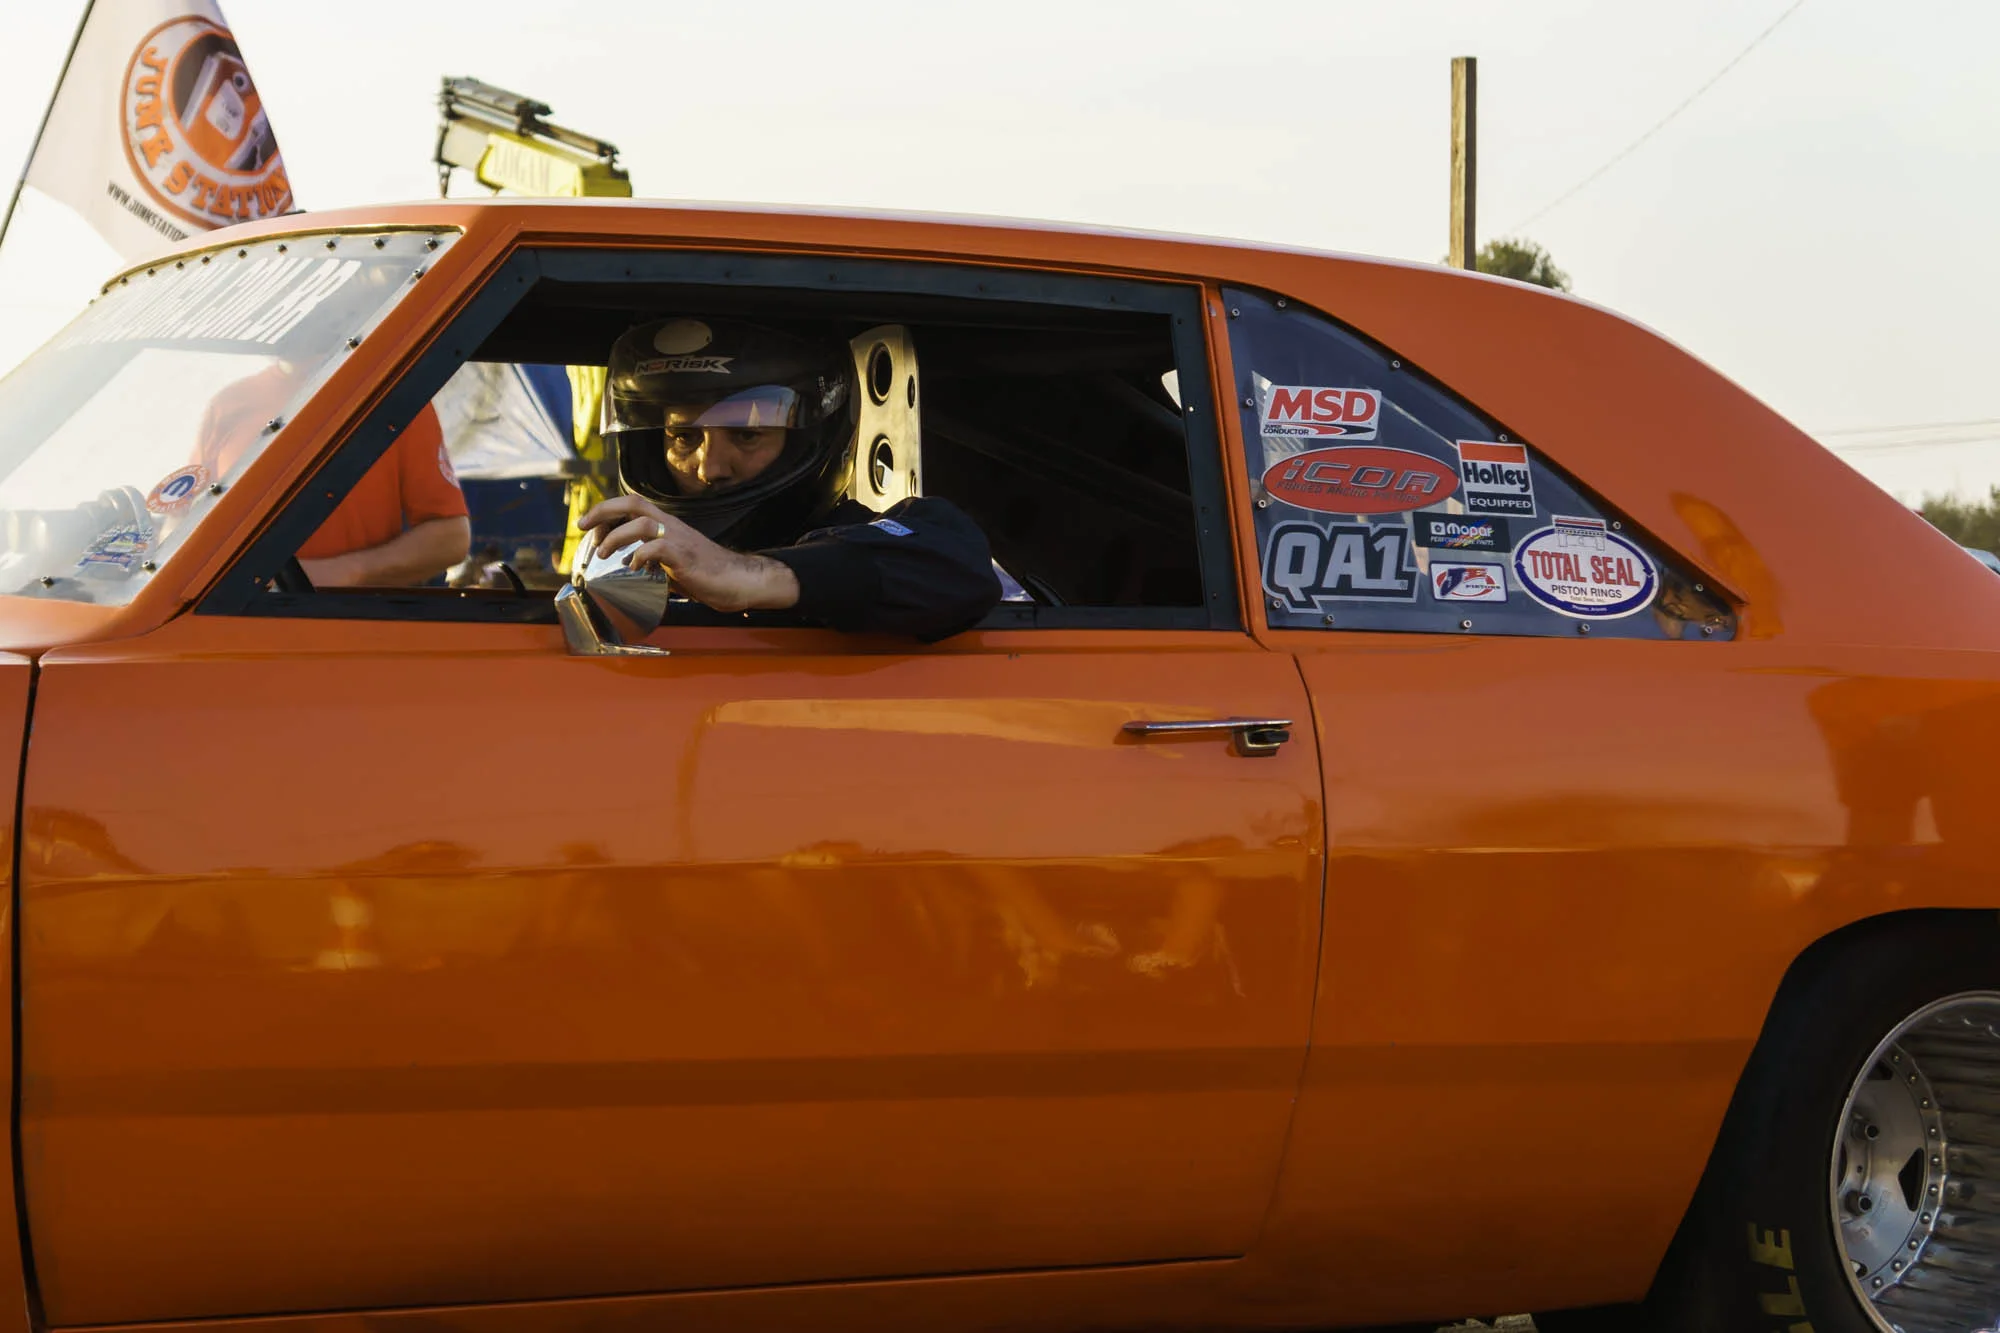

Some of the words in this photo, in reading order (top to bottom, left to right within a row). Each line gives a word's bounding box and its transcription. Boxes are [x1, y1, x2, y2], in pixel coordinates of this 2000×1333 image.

[135, 47, 174, 168] JUNK
[163, 160, 289, 217] STATION
[1268, 388, 1376, 422] MSD
[1462, 461, 1531, 493] Holley
[1469, 498, 1532, 508] EQUIPPED
[1272, 529, 1409, 603] QA1
[1527, 550, 1587, 583] TOTAL
[1590, 555, 1641, 587] SEAL
[1551, 584, 1588, 596] PISTON
[1590, 587, 1622, 598] RINGS
